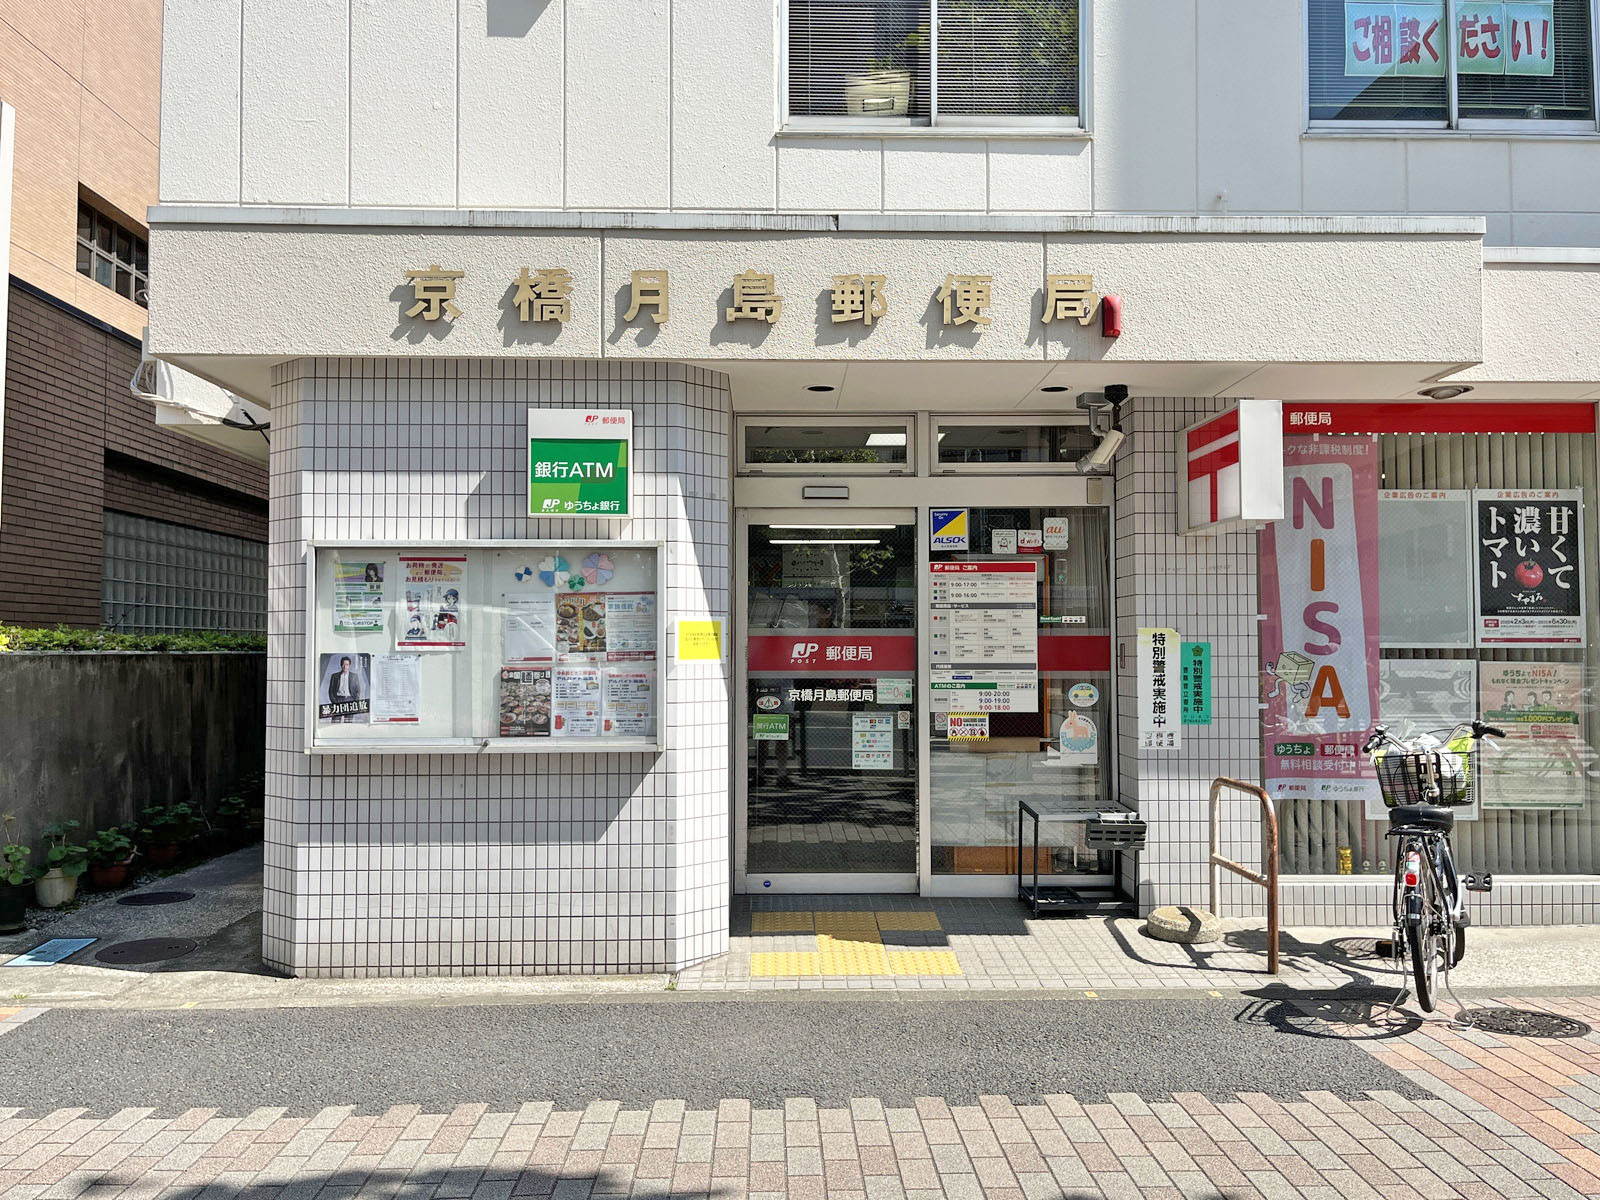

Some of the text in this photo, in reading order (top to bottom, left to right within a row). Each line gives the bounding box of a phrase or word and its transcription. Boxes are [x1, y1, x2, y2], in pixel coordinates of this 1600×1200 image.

[1353, 14, 1549, 64] ご相談ください!
[405, 265, 1098, 326] 京橋月島郵便局
[602, 416, 626, 425] 郵便局
[1290, 411, 1332, 426] 郵便局
[1283, 444, 1369, 456] クな非課税制度!
[534, 461, 613, 478] 銀行ATM
[1383, 491, 1447, 499] 企業広告のご案内
[1497, 490, 1560, 499] 企業広告のご案内
[564, 500, 620, 511] ゆうちょ銀行
[1046, 525, 1065, 534] au
[1513, 505, 1542, 557] 濃い
[933, 536, 966, 544] ALSOK
[1546, 505, 1574, 589] 甘くて
[1482, 506, 1510, 589] トマト
[825, 645, 873, 661] 郵便局
[1152, 632, 1166, 728] 特別警戒実施中
[788, 688, 874, 702] 京橋月島郵便局
[321, 701, 368, 715] 暴力団追放
[950, 717, 963, 727] NO
[1276, 744, 1312, 755] ゆうちょ
[1288, 784, 1307, 792] 郵便局
